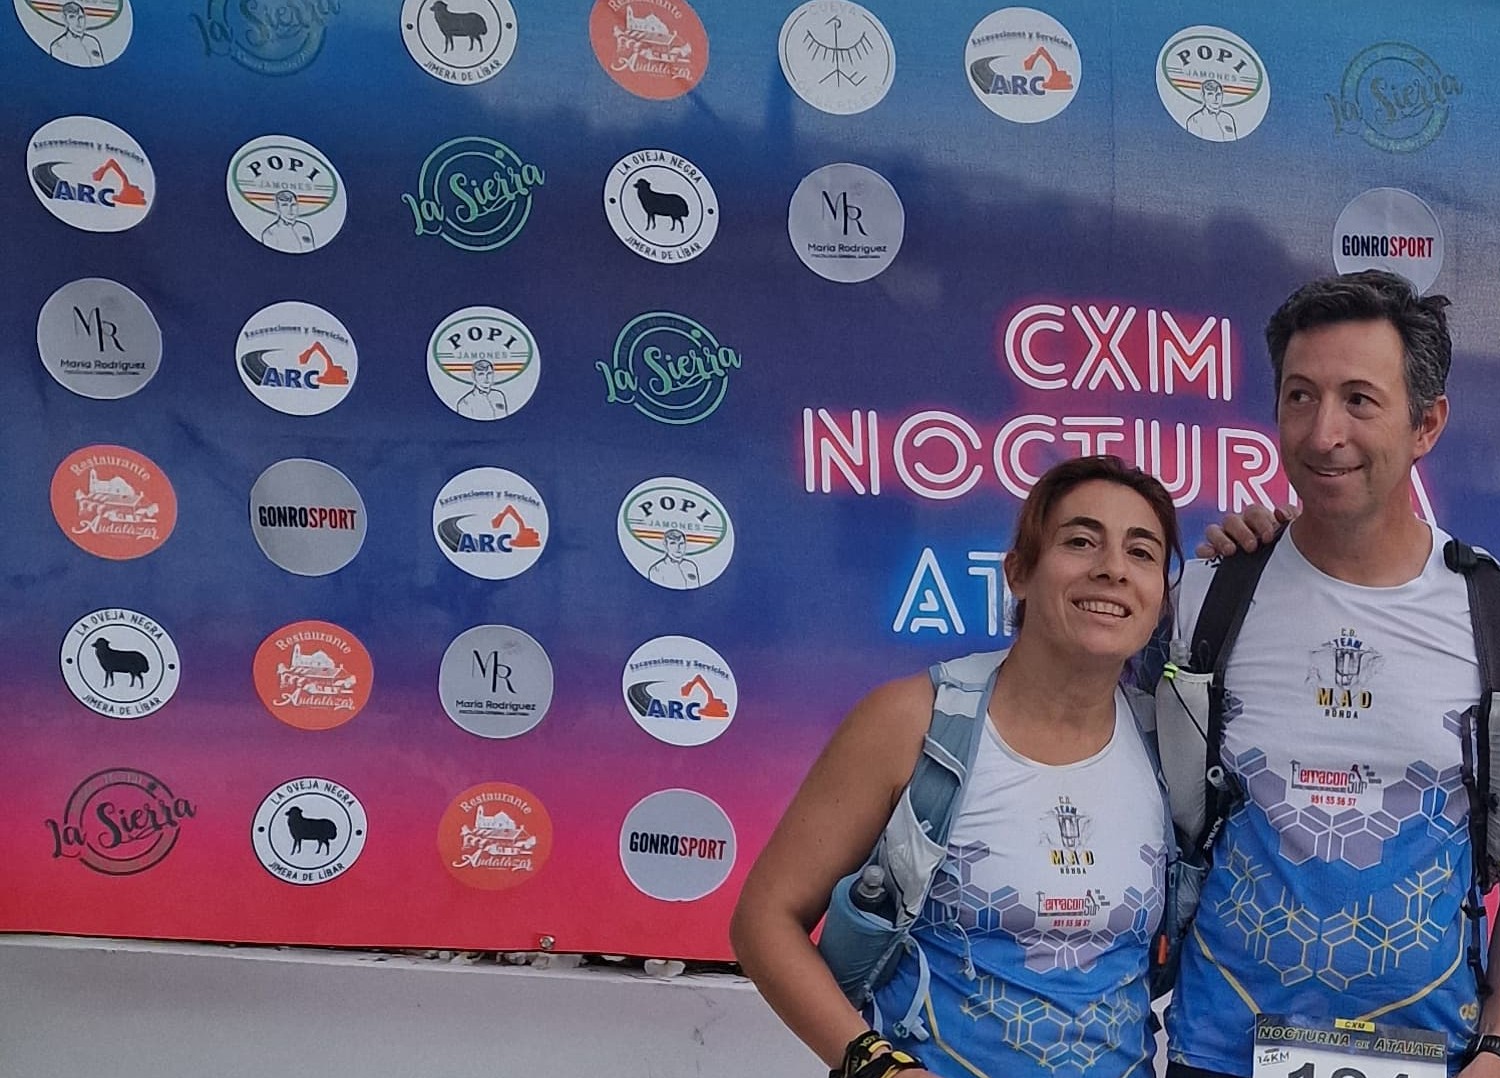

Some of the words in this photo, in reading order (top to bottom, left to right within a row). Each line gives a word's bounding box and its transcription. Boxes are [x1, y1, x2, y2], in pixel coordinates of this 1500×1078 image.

[423, 59, 457, 81] JIMERA
[461, 71, 474, 81] DE
[1177, 45, 1247, 73] POPI
[991, 75, 1046, 96] ARC
[247, 155, 322, 182] POPI
[616, 162, 632, 176] LA
[632, 151, 665, 166] OVEJA
[670, 155, 702, 184] NEGRA
[54, 180, 116, 207] ARC
[449, 164, 545, 223] Sierra
[624, 235, 658, 258] JIMERA
[661, 249, 674, 259] DE
[1342, 235, 1434, 258] GONROSPORT
[448, 326, 518, 350] POPI
[1005, 304, 1232, 401] CXM
[262, 367, 320, 390] ARC
[643, 345, 742, 396] Sierra
[70, 455, 151, 481] Restaurante
[258, 505, 357, 531] GONROSPORT
[638, 496, 712, 521] POPI
[459, 534, 512, 553] ARC
[75, 621, 91, 636] LA
[91, 610, 126, 624] OVEJA
[130, 612, 164, 641] NEGRA
[275, 631, 352, 654] Restaurante
[1333, 638, 1363, 649] TEAM
[81, 693, 116, 715] JIMERA
[119, 706, 133, 716] DE
[647, 698, 701, 721] ARC
[1318, 688, 1372, 709] MAD
[1325, 709, 1358, 719] RONDA
[270, 790, 285, 806] LA
[286, 780, 320, 795] OVEJA
[324, 781, 356, 808] NEGRA
[459, 792, 532, 814] Restaurante
[96, 797, 198, 850] Sierra
[630, 831, 726, 860] GONROSPORT
[1051, 850, 1095, 865] MAD
[268, 862, 299, 880] JIMERA
[302, 872, 315, 881] DE
[1259, 1026, 1349, 1046] NOCTURNA
[1374, 1037, 1445, 1058] ATAJATE
[1258, 1052, 1290, 1064] 14KM
